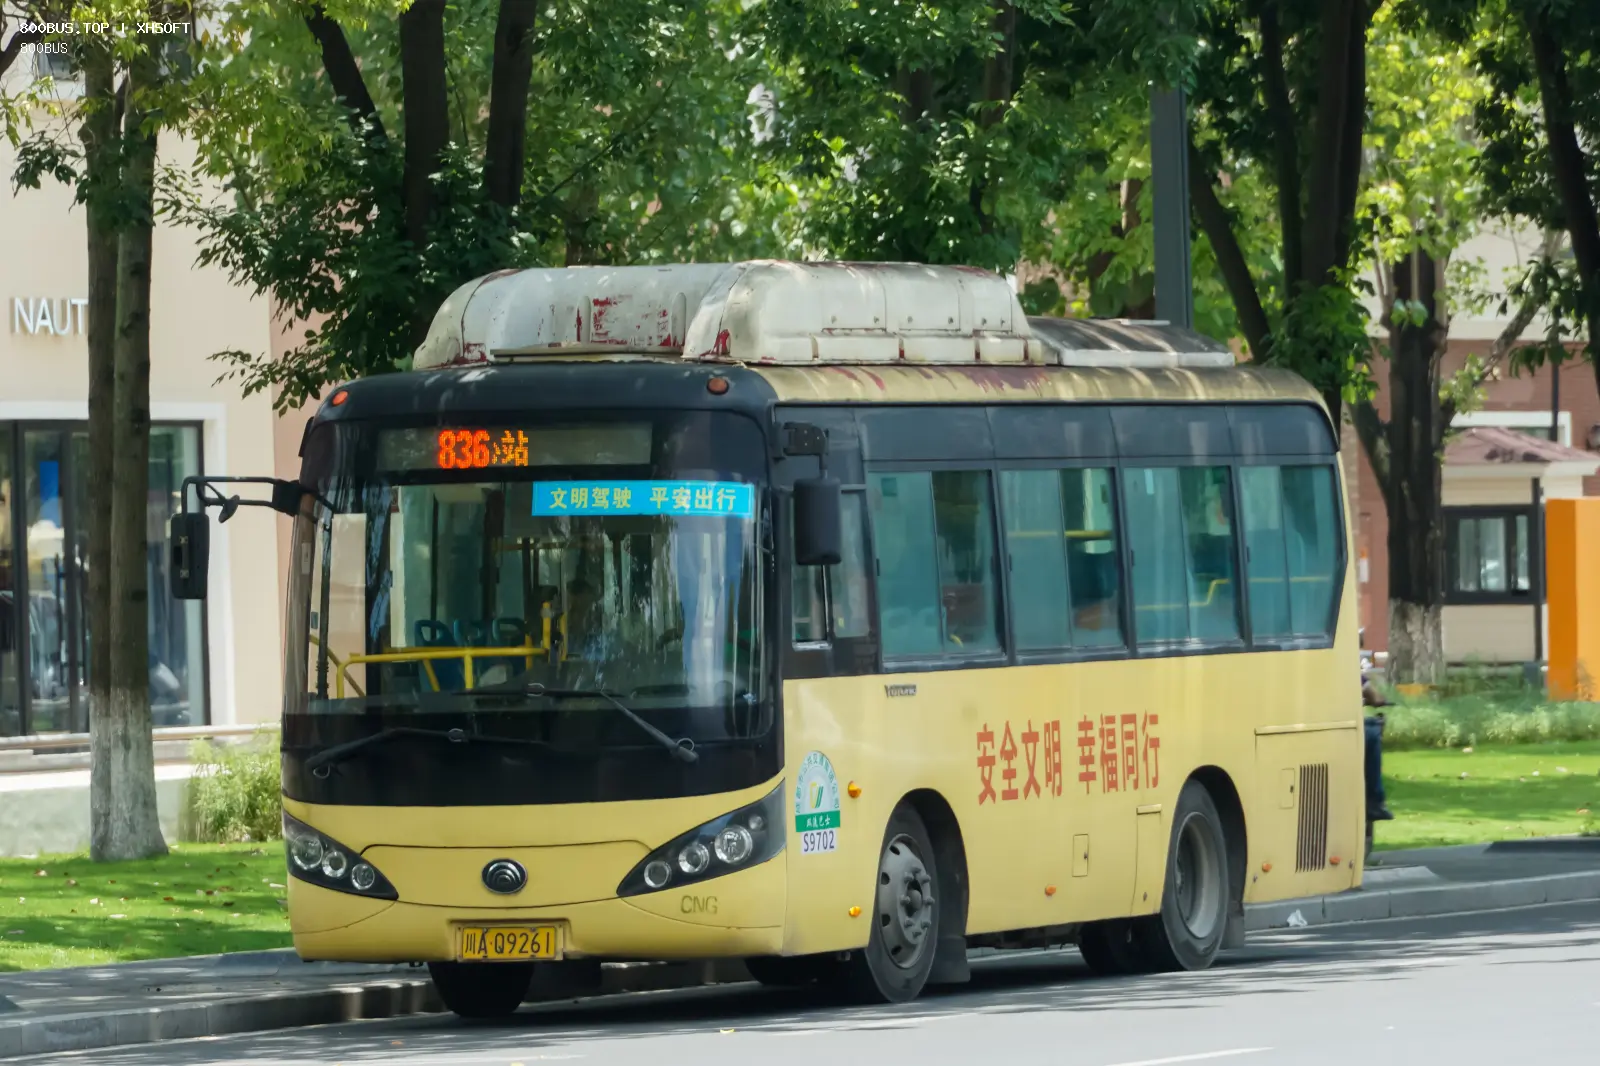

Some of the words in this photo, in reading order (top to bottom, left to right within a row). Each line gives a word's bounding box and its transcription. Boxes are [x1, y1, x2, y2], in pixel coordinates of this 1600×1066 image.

[14, 297, 89, 335] NAUT
[438, 429, 490, 469] 836
[549, 487, 632, 509] 文明驾驶
[649, 486, 737, 511] 平安出行
[976, 719, 1063, 806] 安全文明
[1077, 709, 1161, 795] 幸福同行
[803, 830, 835, 852] S9702
[681, 895, 718, 914] CNG
